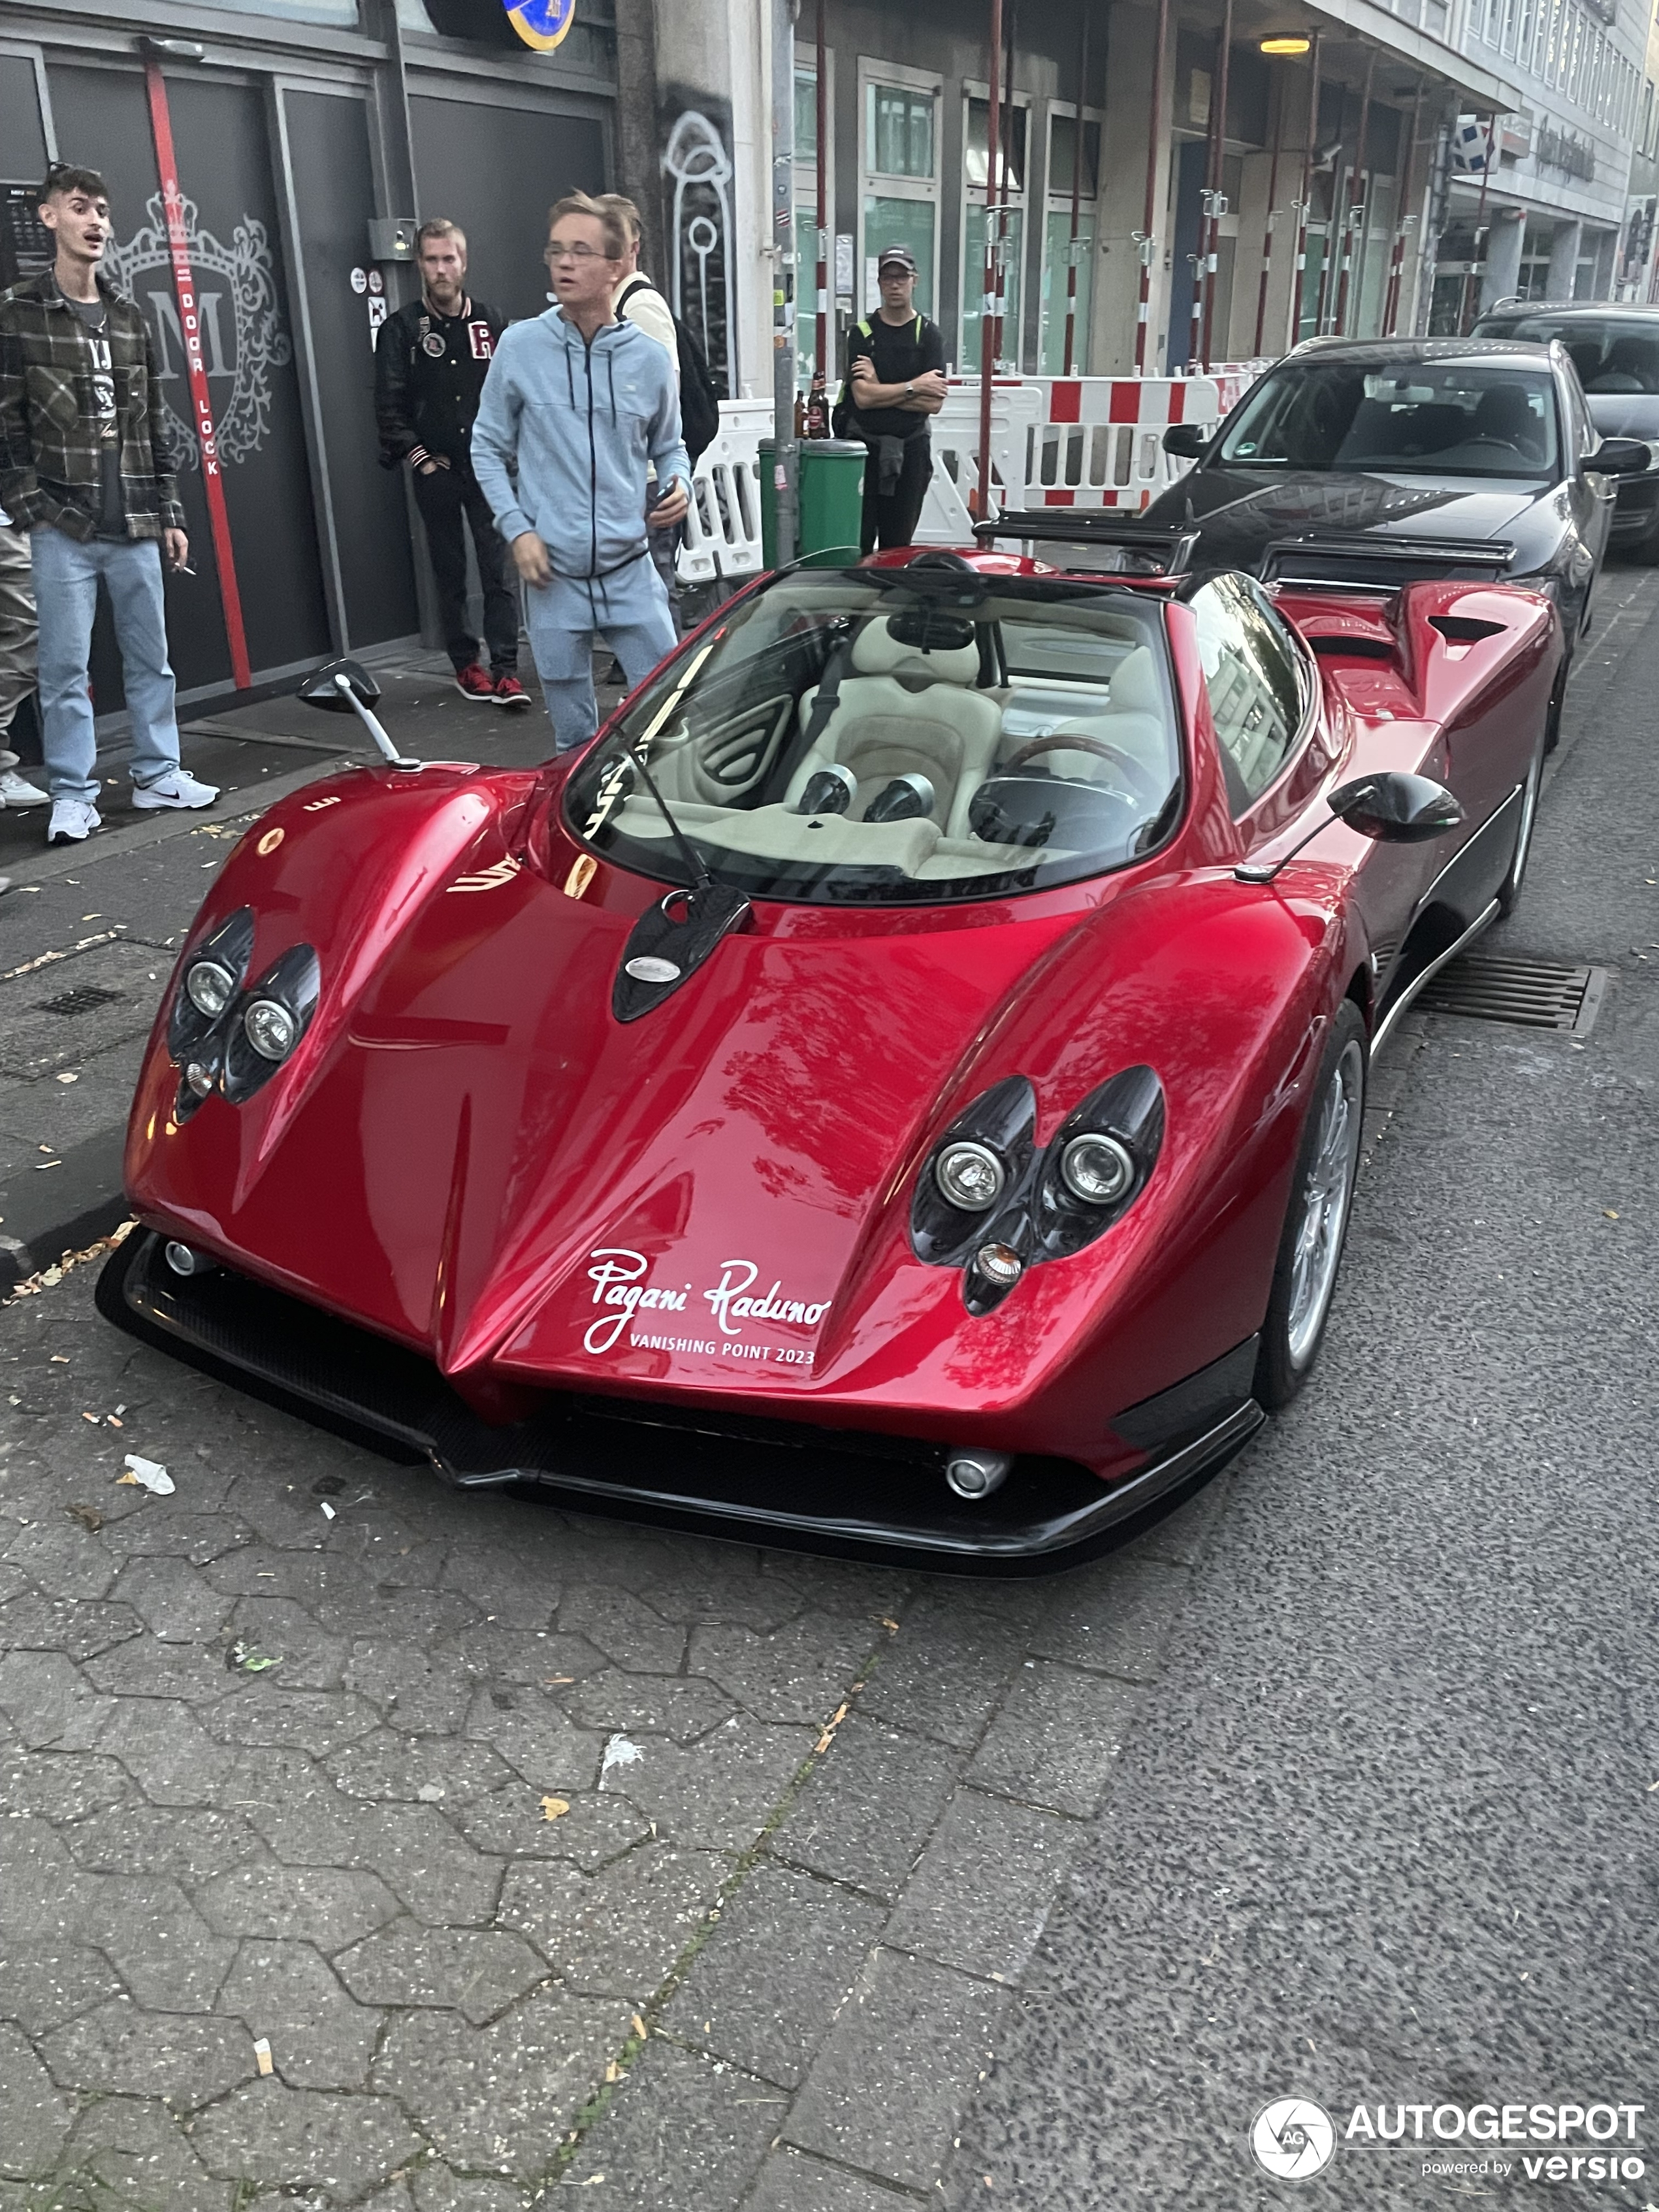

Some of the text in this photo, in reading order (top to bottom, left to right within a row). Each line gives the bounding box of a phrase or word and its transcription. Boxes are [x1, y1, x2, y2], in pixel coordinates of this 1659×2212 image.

[468, 321, 496, 359] R
[182, 294, 203, 372] DOOR
[199, 400, 219, 475] LOCK
[583, 1247, 833, 1354] Pagani Raduno
[630, 1333, 815, 1365] VANISHING POINT 2023
